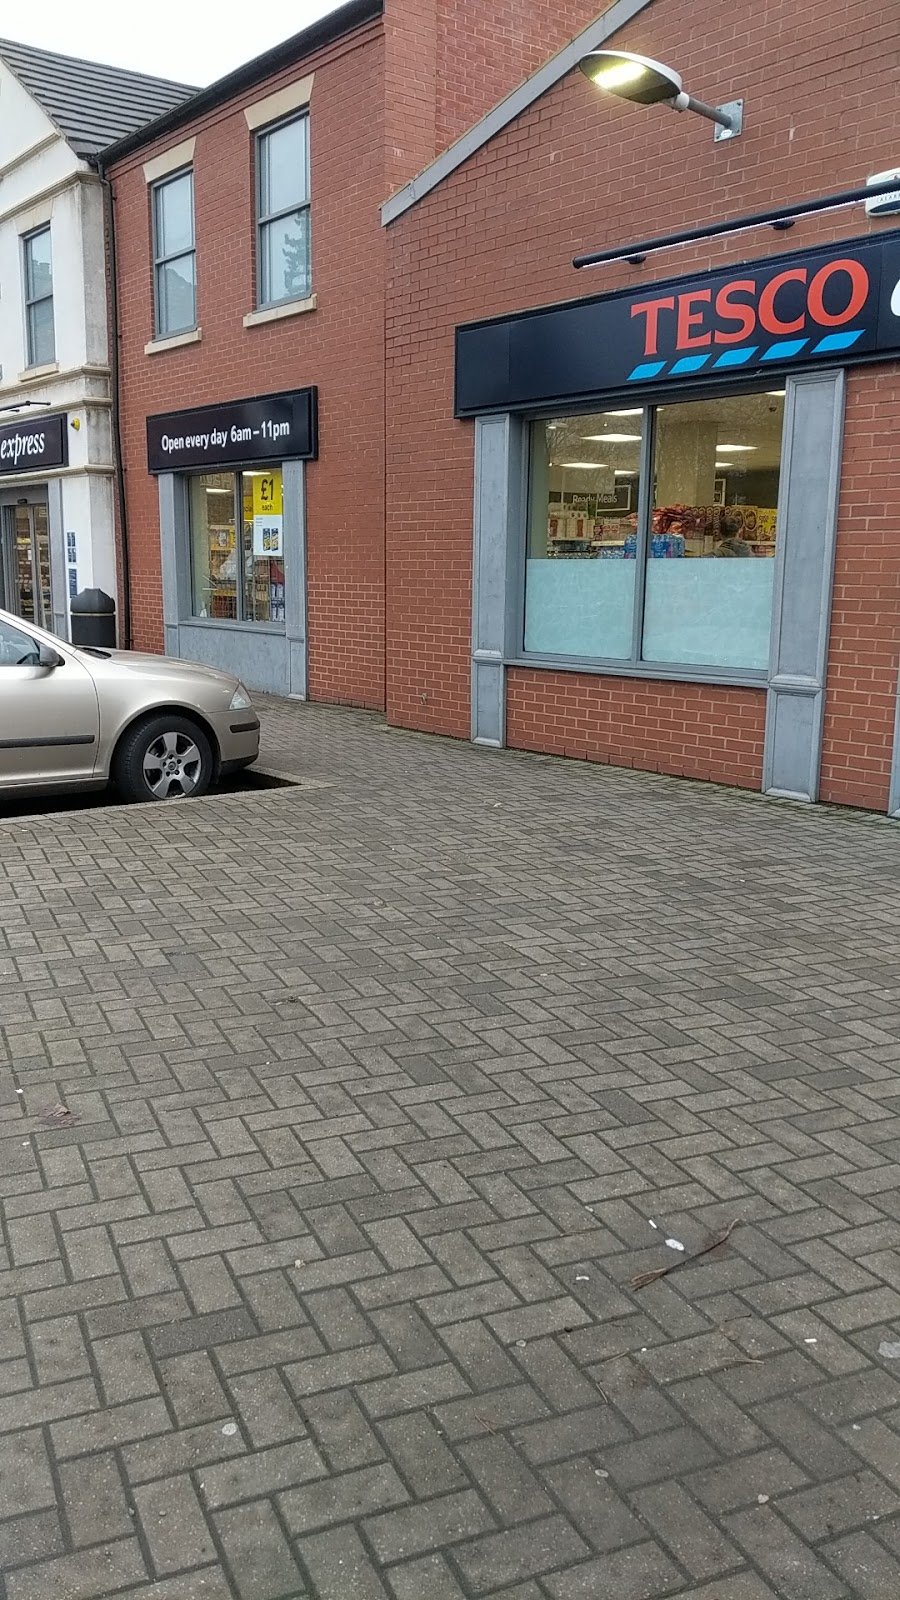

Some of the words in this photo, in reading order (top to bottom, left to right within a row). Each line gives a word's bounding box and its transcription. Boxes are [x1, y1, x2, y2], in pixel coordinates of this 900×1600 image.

[630, 258, 869, 356] TESCO
[0, 433, 45, 465] express
[161, 434, 184, 453] Open
[185, 433, 210, 450] every
[210, 428, 228, 447] day
[260, 478, 274, 501] £1
